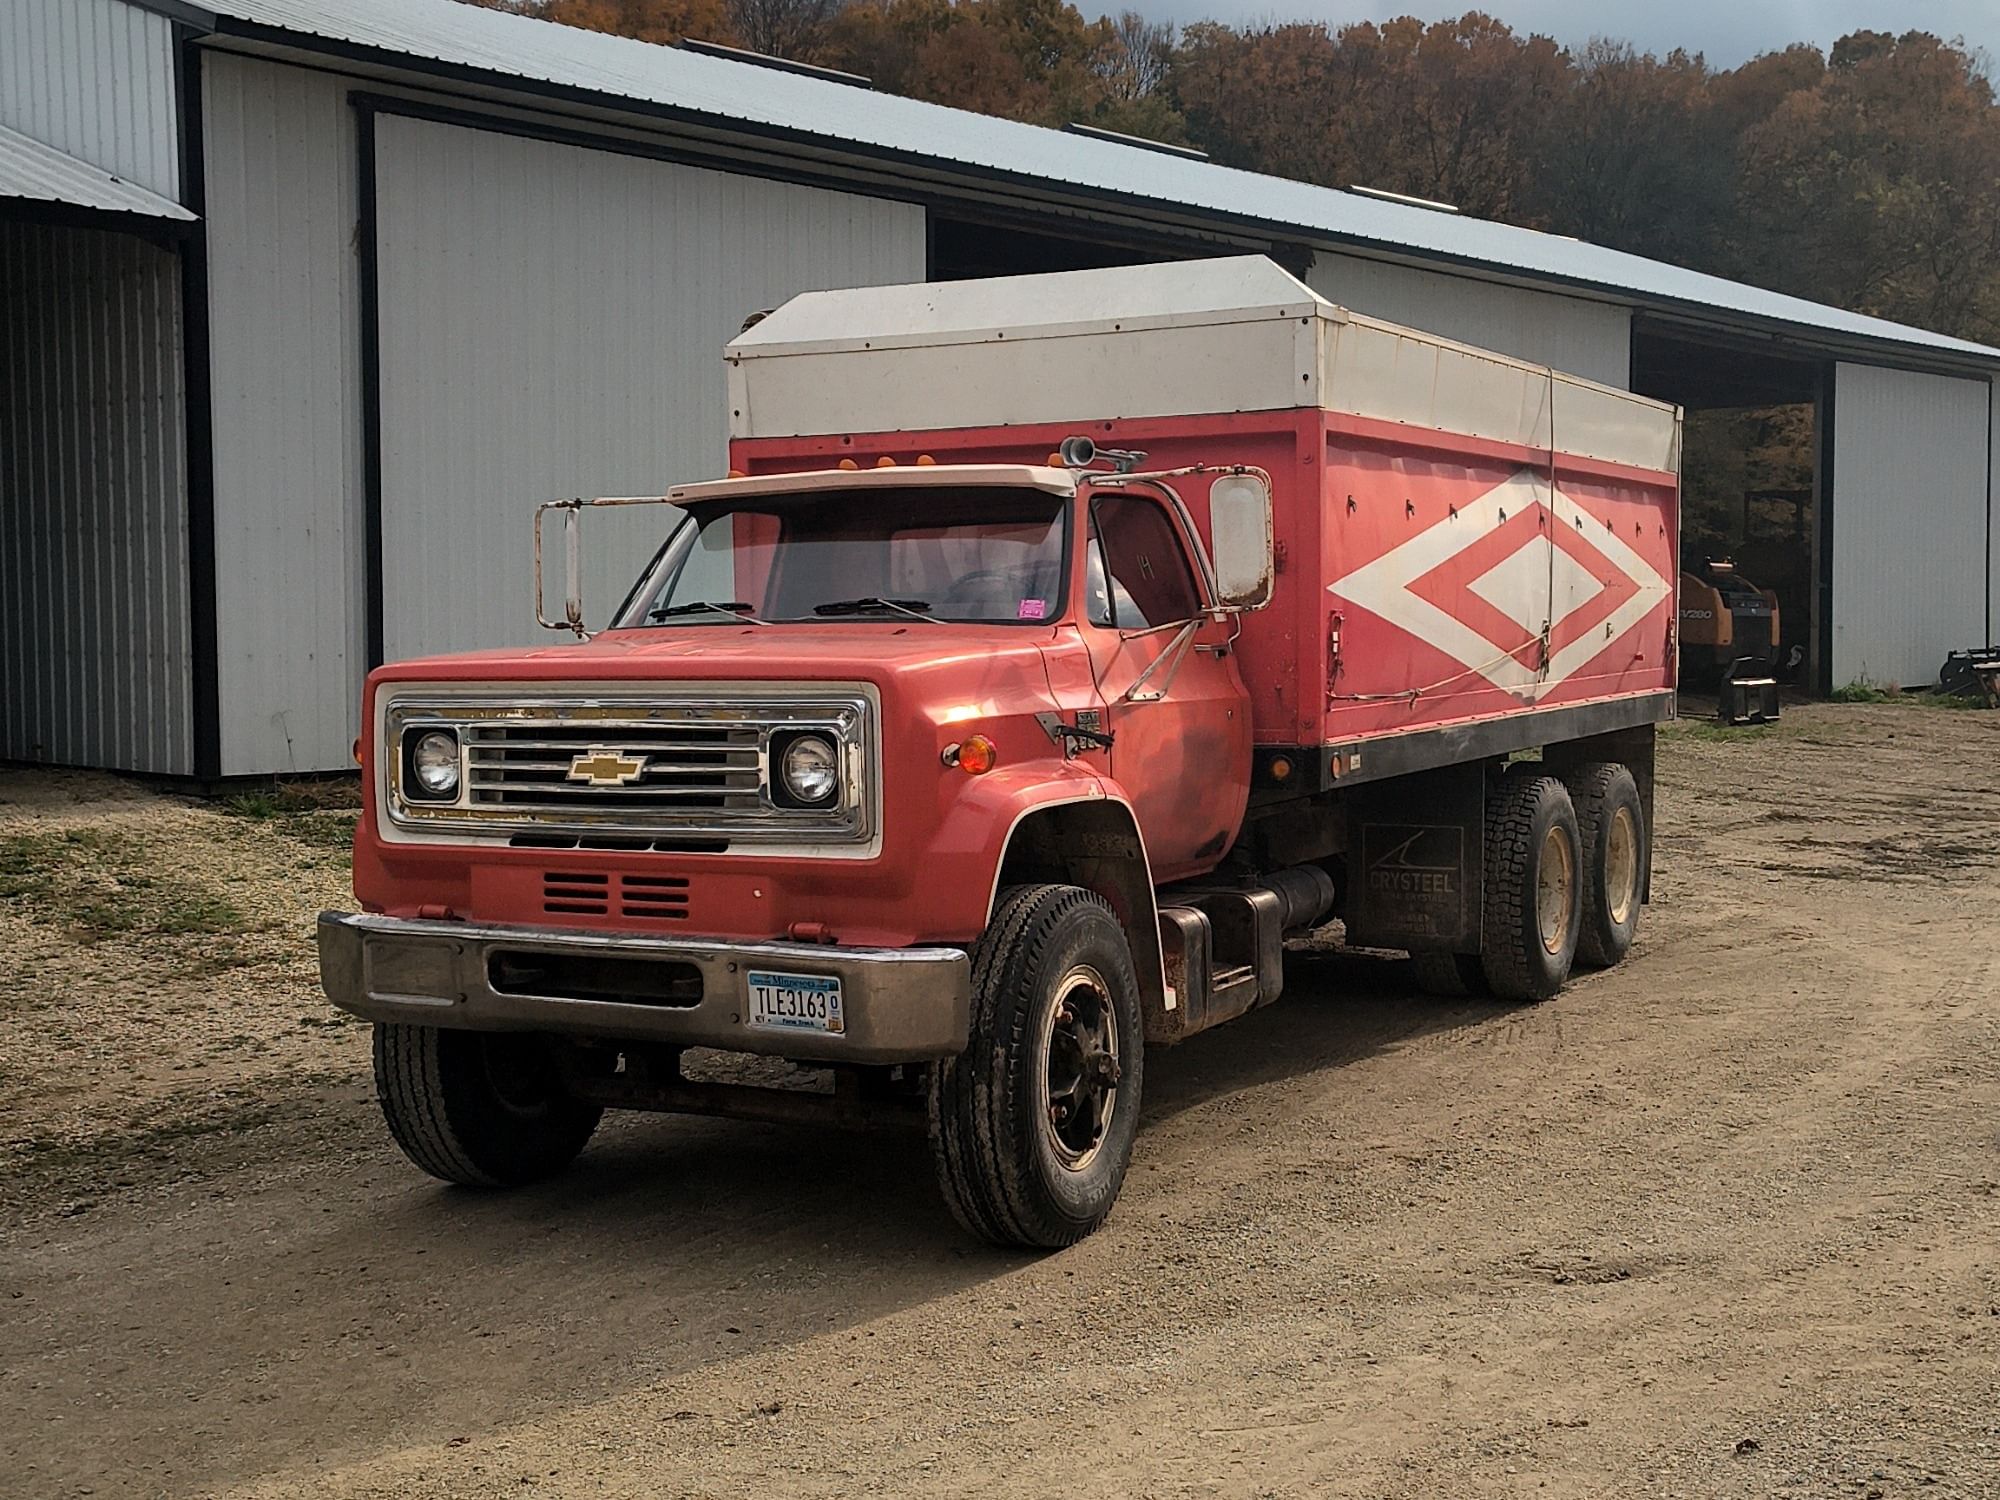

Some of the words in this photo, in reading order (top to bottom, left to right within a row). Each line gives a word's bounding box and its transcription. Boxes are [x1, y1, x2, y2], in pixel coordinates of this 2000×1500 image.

[1680, 609, 1712, 619] V280
[1369, 871, 1455, 893] CRYSTEEL
[772, 975, 816, 989] Minnesota
[757, 987, 826, 1019] TLE3163
